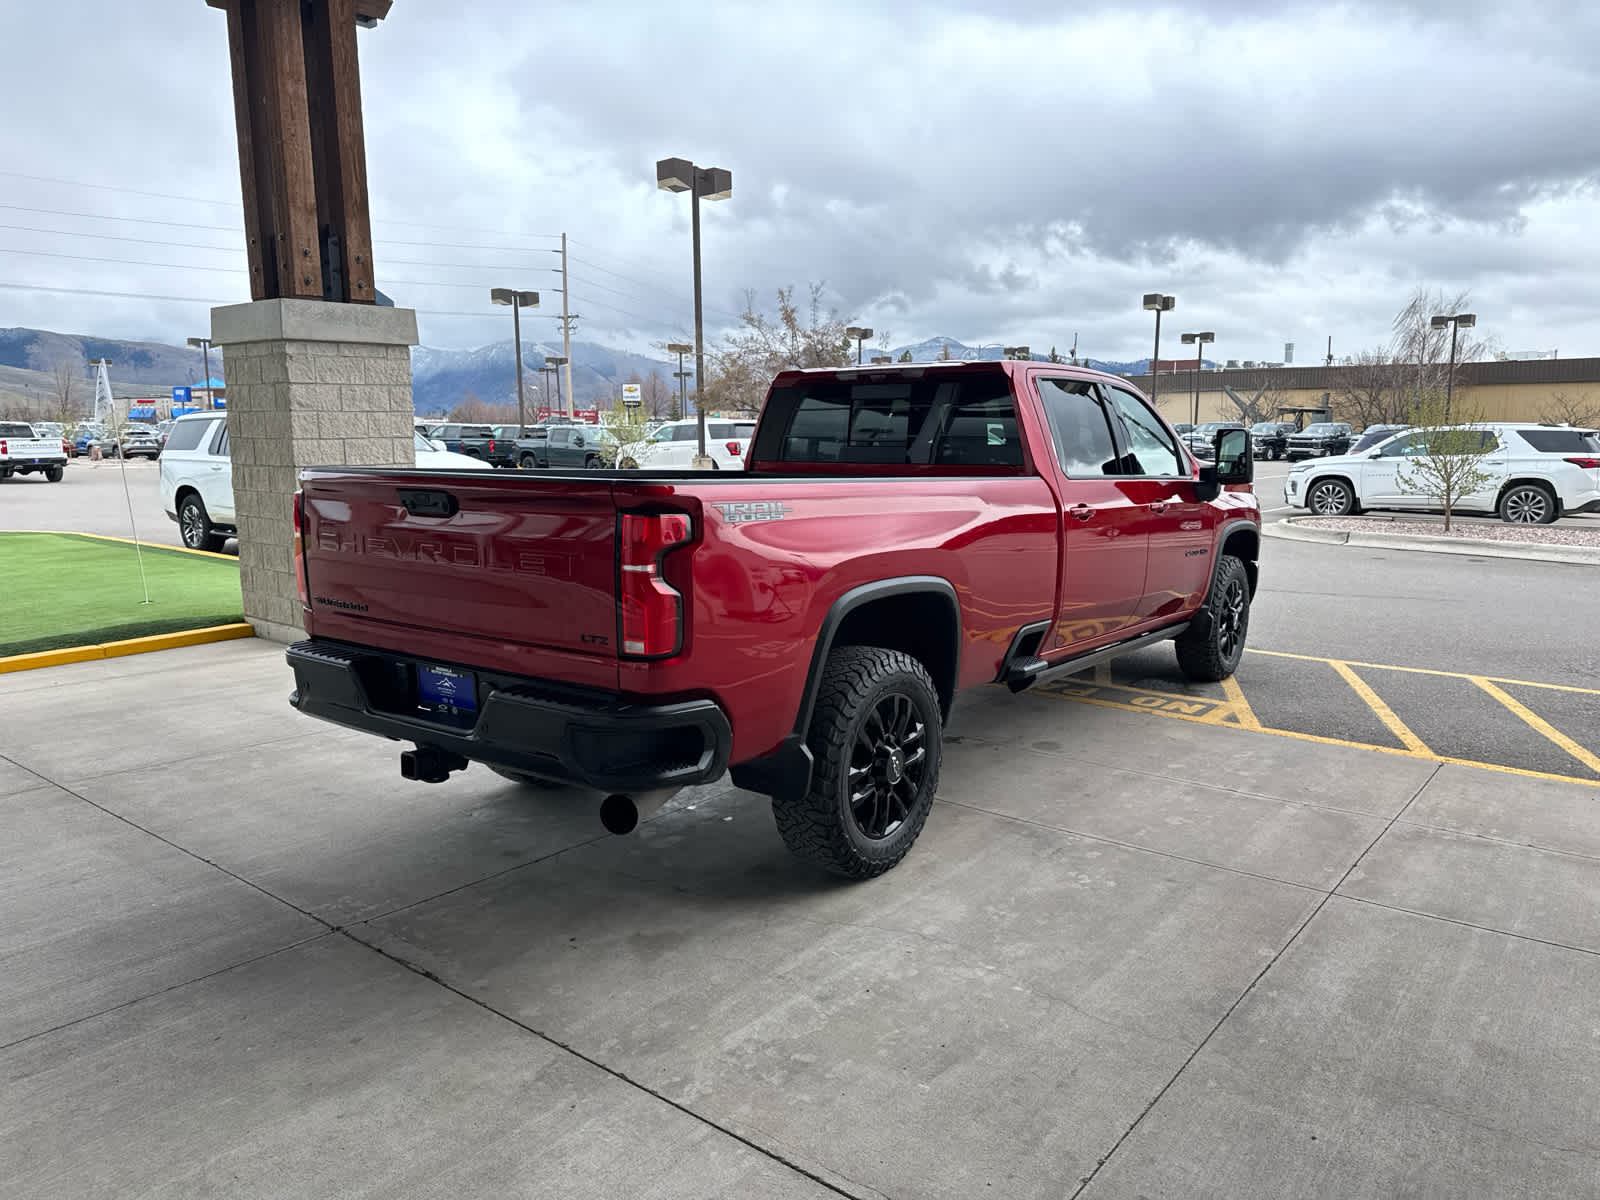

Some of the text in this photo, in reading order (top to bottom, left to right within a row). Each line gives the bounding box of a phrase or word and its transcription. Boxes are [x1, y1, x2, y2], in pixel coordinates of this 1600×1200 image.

[712, 502, 793, 514] TRAIL
[317, 521, 583, 577] CHEVROLET
[580, 634, 609, 646] LTZ
